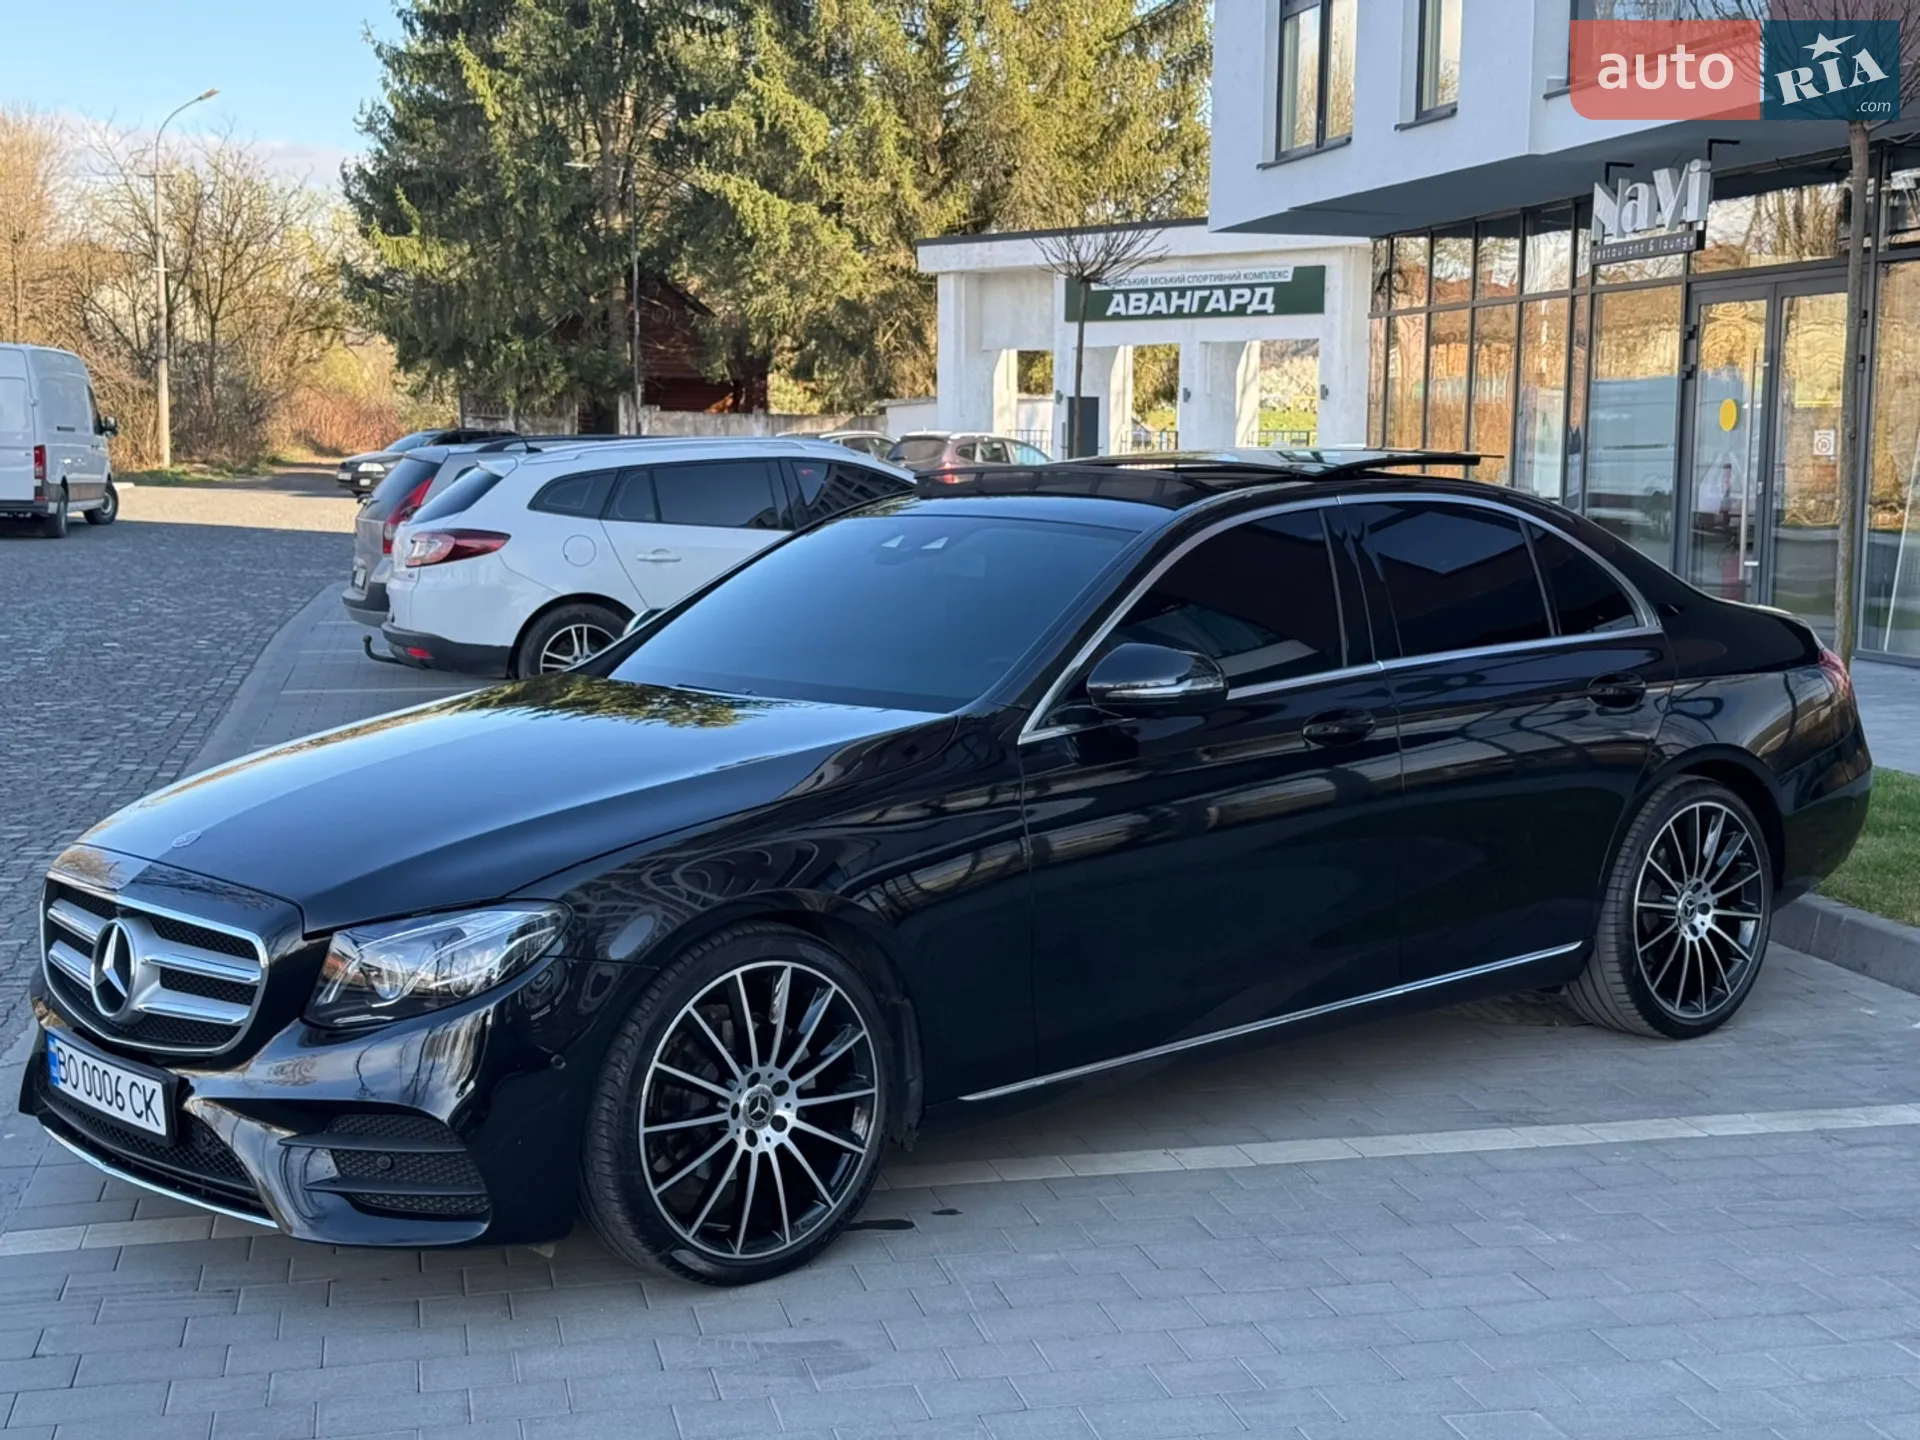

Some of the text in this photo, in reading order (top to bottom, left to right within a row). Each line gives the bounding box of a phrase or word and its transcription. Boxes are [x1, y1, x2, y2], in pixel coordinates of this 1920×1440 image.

[1187, 271, 1241, 284] СПОРТИВНИЙ
[1243, 270, 1289, 281] КОМПЛЕКС
[1105, 287, 1276, 316] АВАНГАРД
[56, 1046, 161, 1127] BO 0006 CK
